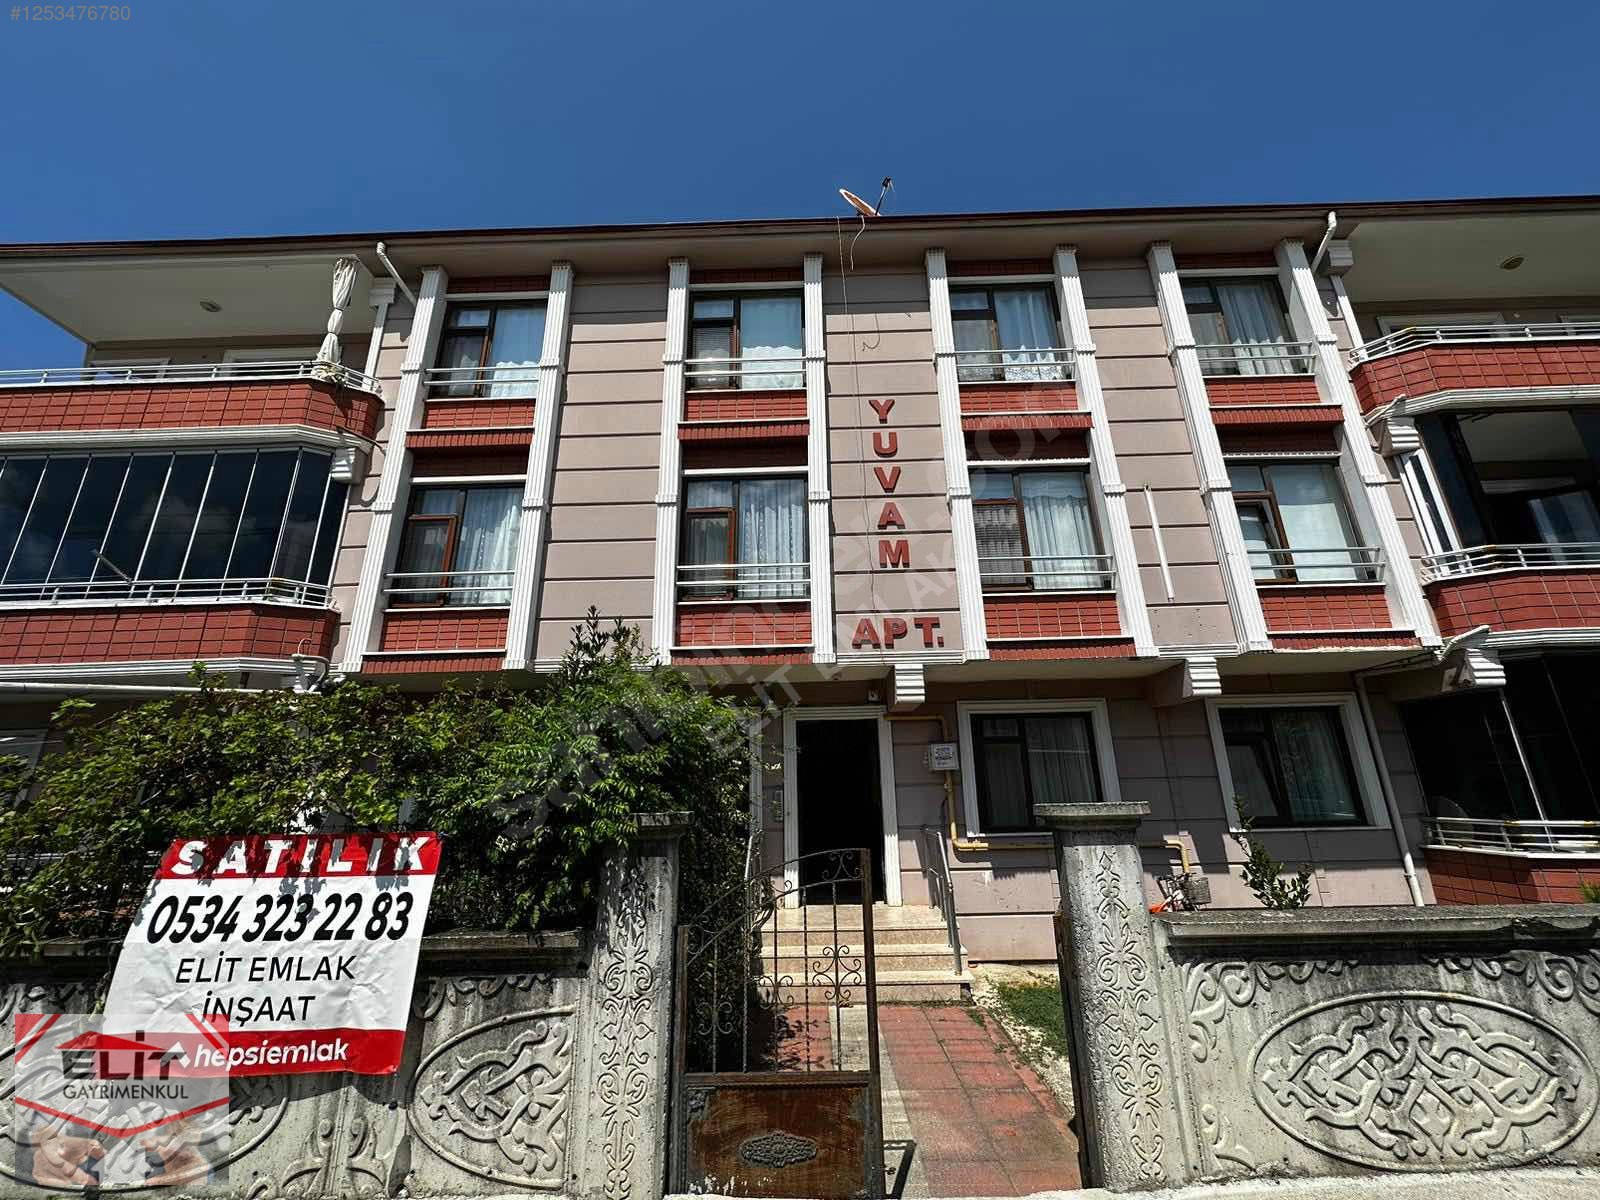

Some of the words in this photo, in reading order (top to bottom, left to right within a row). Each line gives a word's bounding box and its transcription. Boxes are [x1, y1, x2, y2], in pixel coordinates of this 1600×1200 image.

[868, 399, 910, 568] YUVAM
[851, 617, 944, 649] APT.
[170, 836, 430, 875] SATILIK
[147, 895, 243, 944] 0534
[242, 894, 314, 942] 323
[313, 893, 363, 941] 22
[365, 891, 414, 941] 83
[175, 951, 243, 983] ELİT
[249, 955, 356, 982] EMLAK
[201, 991, 316, 1026] İNŞAAT
[194, 1039, 350, 1072] hepsiemlak
